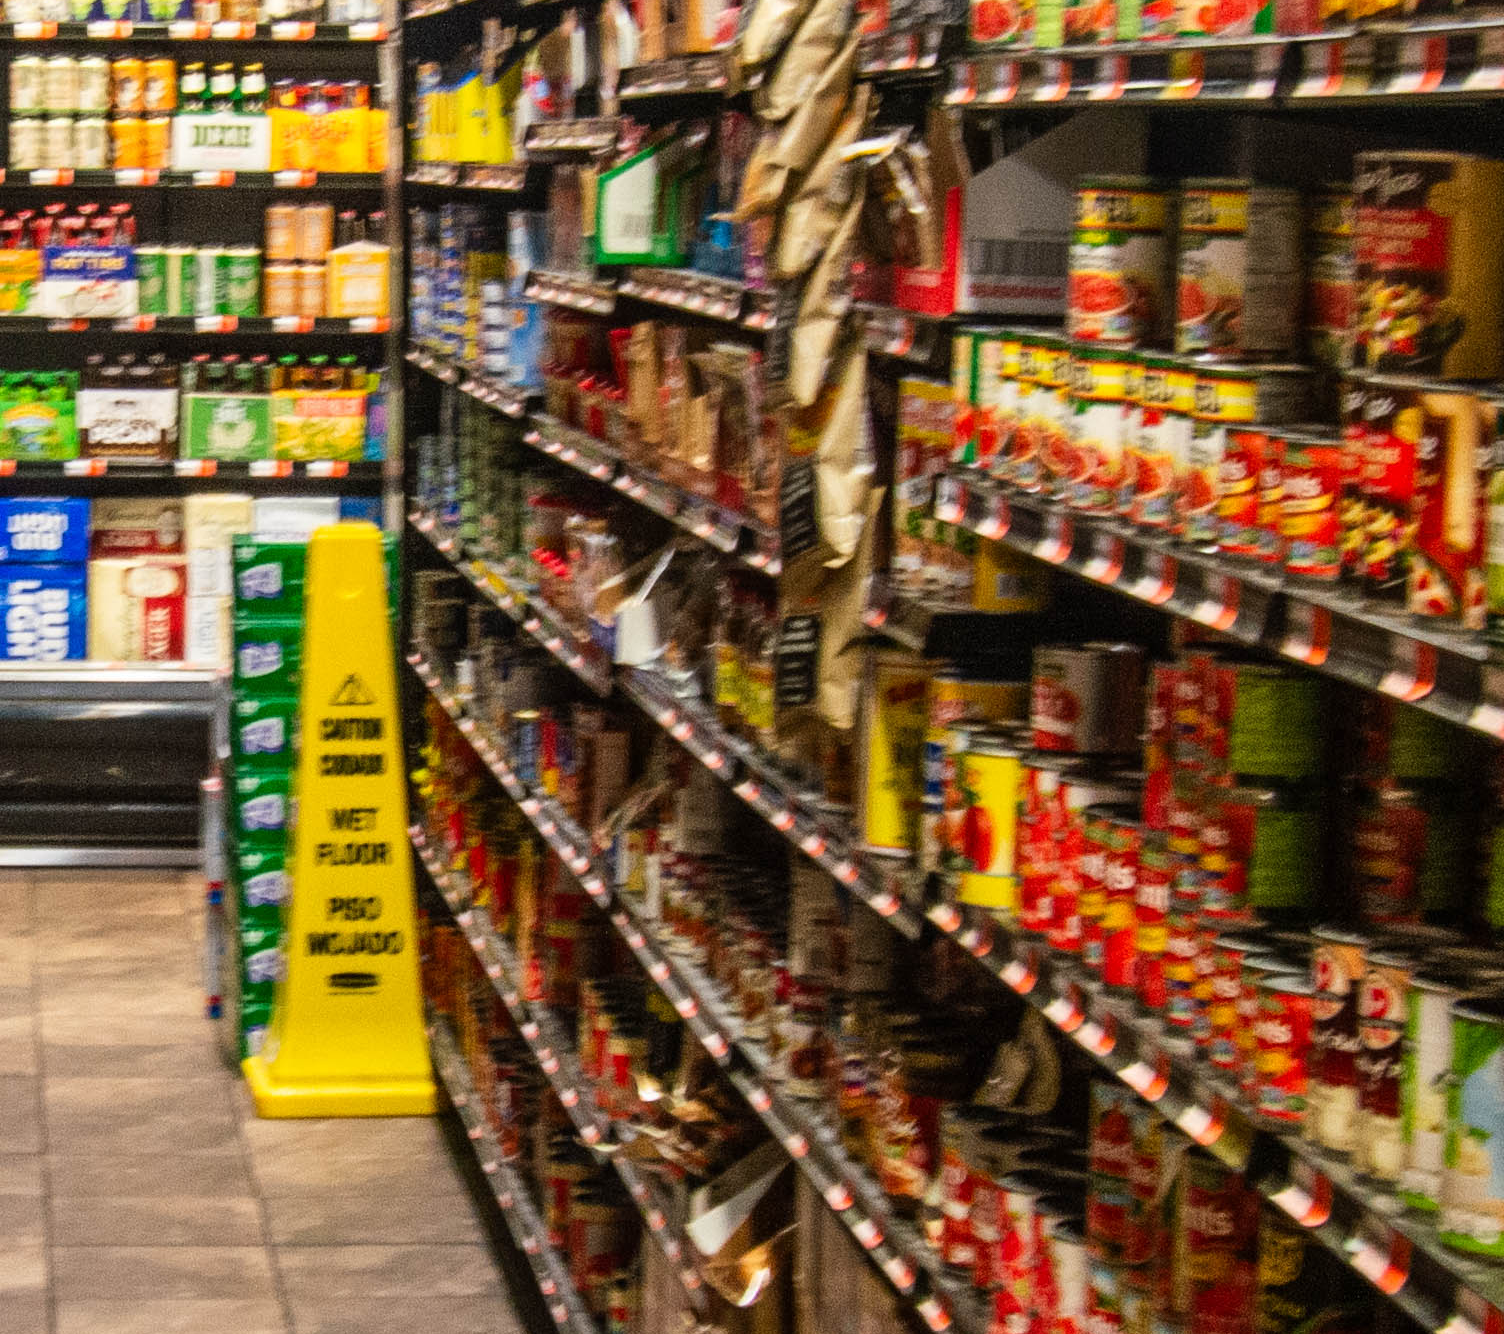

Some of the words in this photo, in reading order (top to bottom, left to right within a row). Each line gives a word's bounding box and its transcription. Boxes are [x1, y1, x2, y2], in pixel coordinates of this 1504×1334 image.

[320, 718, 384, 740] CAUTION
[320, 754, 385, 777] CUIDADO
[329, 807, 379, 831] WET
[315, 842, 391, 866] FLOOR
[327, 896, 380, 921] PISO
[306, 931, 403, 955] MOJADO
